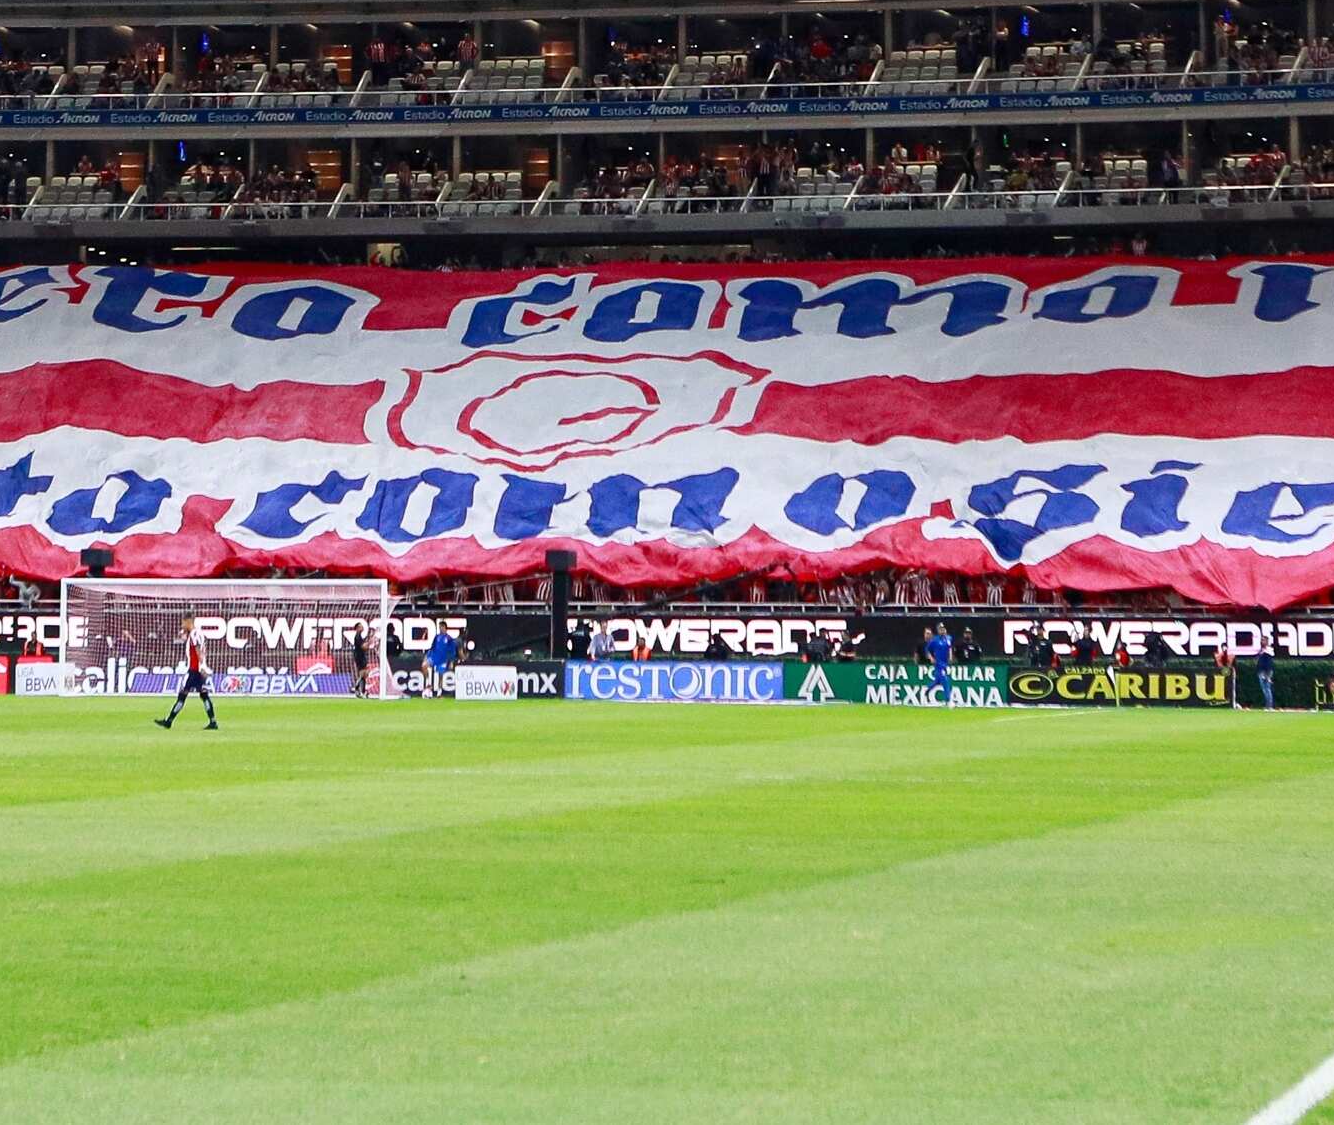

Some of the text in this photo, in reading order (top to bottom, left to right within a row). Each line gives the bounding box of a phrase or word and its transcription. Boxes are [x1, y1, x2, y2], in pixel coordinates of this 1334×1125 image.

[999, 96, 1041, 108] Estadio
[1101, 93, 1143, 106] Estadio
[1204, 89, 1247, 103] Estadio
[600, 105, 641, 117] Estadio
[699, 102, 740, 115] Estadio
[799, 100, 840, 113] Estadio
[899, 99, 940, 110] Estadio
[13, 113, 53, 124] Estadio
[110, 112, 150, 123] Estadio
[208, 111, 248, 122] Estadio
[306, 110, 347, 122] Estadio
[404, 109, 444, 120] Estadio
[502, 107, 543, 119] Estadio
[460, 273, 1157, 347] como
[865, 665, 908, 683] CAJA
[25, 678, 57, 693] BBVA
[251, 675, 319, 694] BBVA
[465, 681, 499, 696] BBVA
[1056, 674, 1226, 701] CARIBU
